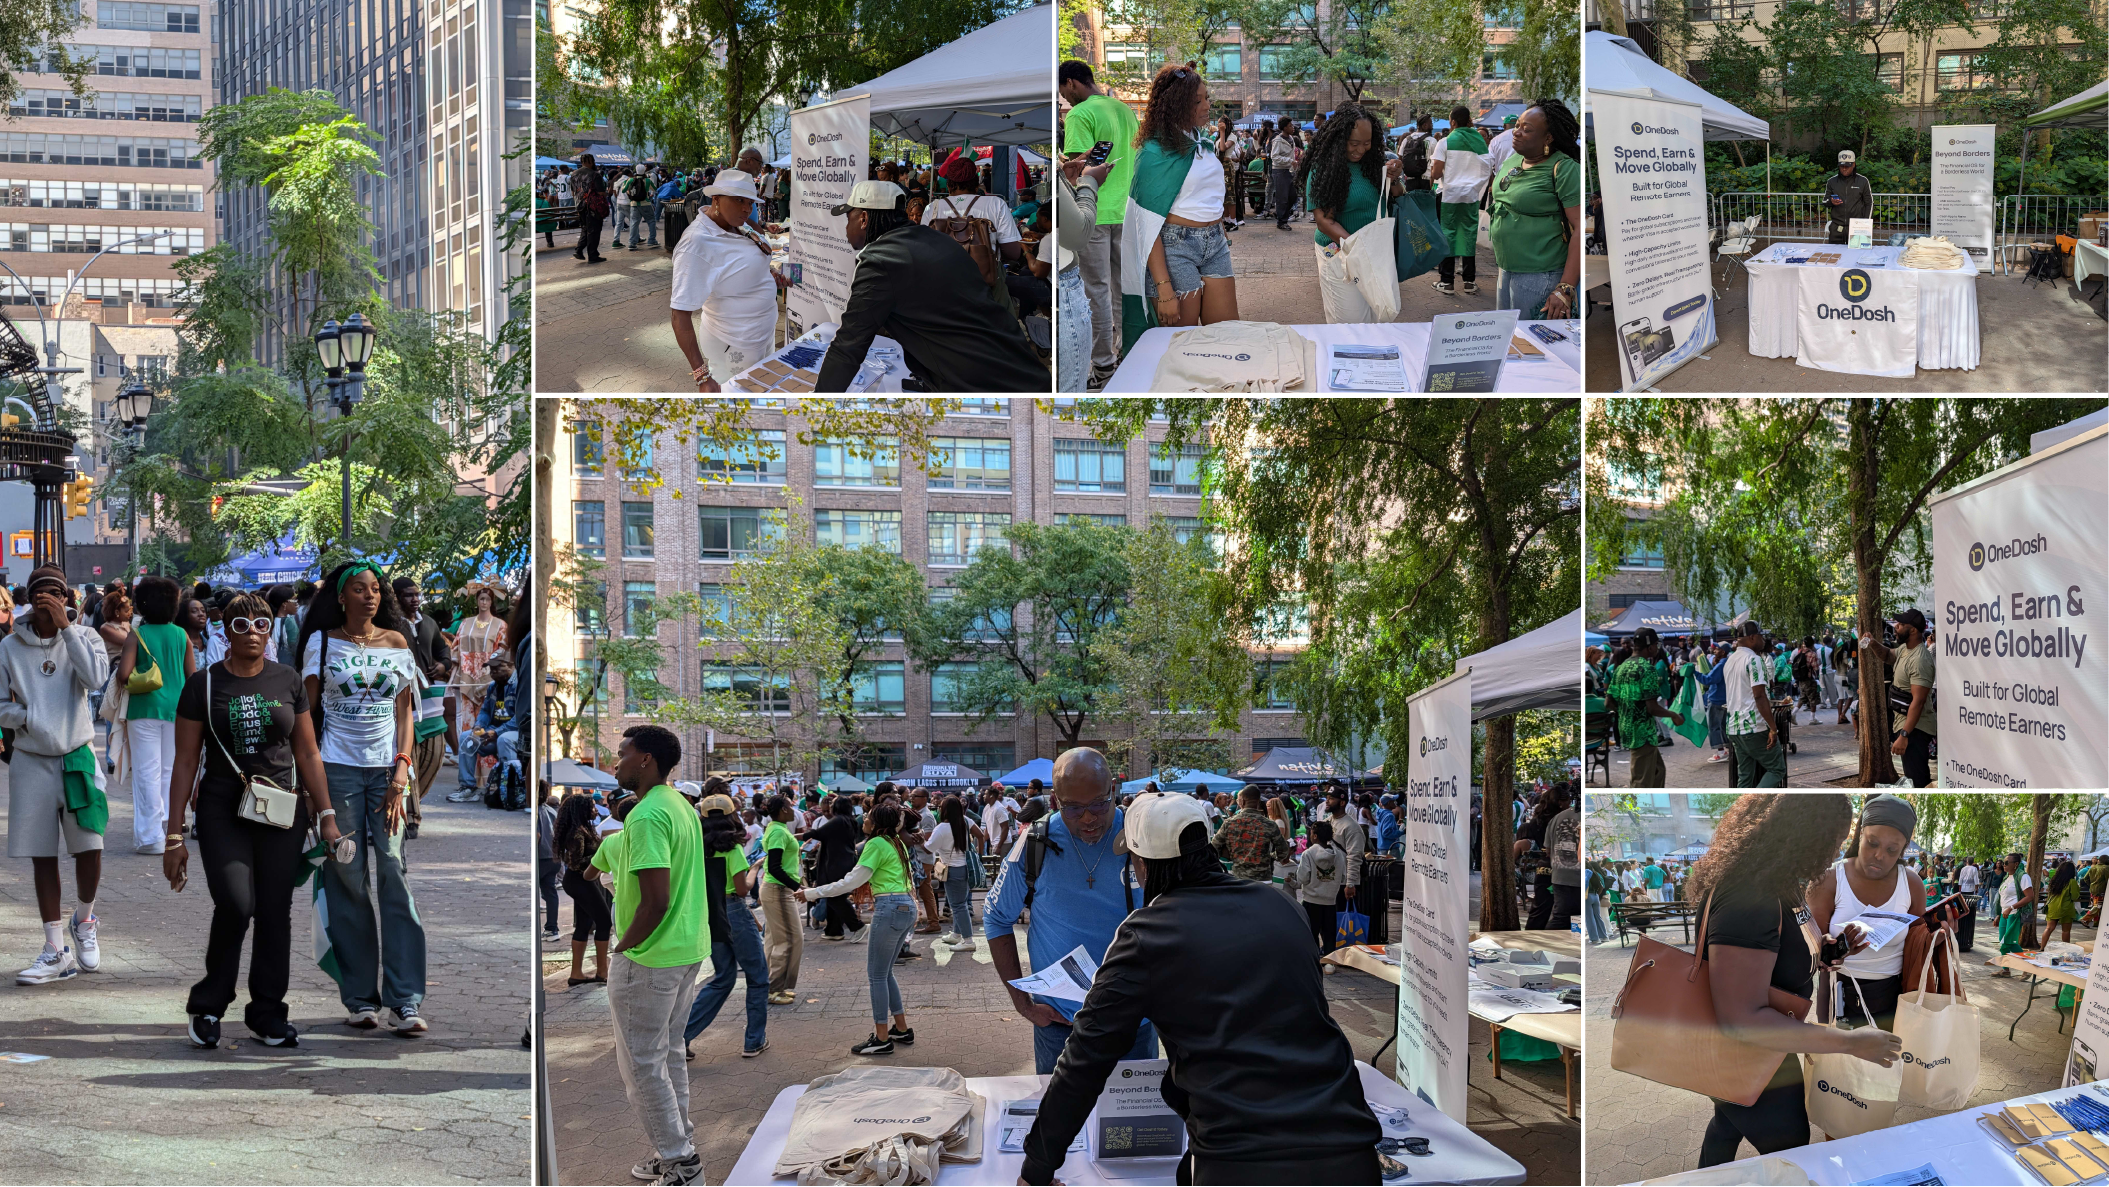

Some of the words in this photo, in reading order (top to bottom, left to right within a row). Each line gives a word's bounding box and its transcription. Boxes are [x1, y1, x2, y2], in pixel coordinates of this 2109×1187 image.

[816, 132, 842, 142] OneDosh
[1645, 126, 1679, 135] OneDosh
[1614, 146, 1659, 162] Spend,
[1662, 148, 1686, 158] Earn
[1689, 148, 1695, 158] &
[796, 156, 824, 170] Spend,
[826, 156, 846, 168] Earn
[849, 154, 856, 166] &
[1615, 162, 1650, 174] Move
[1652, 161, 1696, 174] Globally
[796, 170, 816, 182] Move
[818, 170, 856, 186] Globally
[1633, 182, 1651, 191] Built
[1664, 180, 1688, 189] Global
[801, 200, 821, 208] Remote
[1638, 215, 1661, 223] OneDosh
[1628, 243, 1667, 257] High-Capacity
[1625, 258, 1637, 266] High
[1626, 263, 1654, 275] conversions
[1632, 280, 1645, 289] Zero
[1817, 303, 1895, 322] OneDosh
[1442, 336, 1470, 345] Beyond
[1988, 533, 2047, 562] OneDosh
[258, 572, 276, 584] JERK
[1946, 595, 2005, 632] Spend,
[2011, 592, 2061, 620] Earn
[2067, 585, 2085, 616] &
[1641, 615, 1692, 627] native
[1946, 633, 1991, 658] Move
[1995, 627, 2087, 668] Globally
[1963, 680, 1990, 699] Built
[1993, 682, 2009, 701] for
[2012, 683, 2059, 707] Global
[332, 701, 362, 714] West
[1960, 706, 2006, 730] Remote
[2008, 713, 2066, 741] Earners
[1428, 735, 1448, 752] OneDosh
[1278, 762, 1334, 773] native
[1951, 760, 1965, 774] The
[1966, 764, 2002, 785] OneDosh
[2004, 774, 2026, 788] Card
[1410, 777, 1431, 802] Spend,
[1433, 776, 1450, 798] Earn
[1452, 775, 1457, 798] &
[1946, 776, 1956, 788] Pay
[1409, 803, 1426, 822] Move
[1427, 803, 1457, 834] Globally
[1413, 839, 1424, 854] Built
[1431, 842, 1447, 860] Global
[1411, 858, 1428, 877] Remote
[1429, 864, 1448, 885] Earners
[2093, 1002, 2106, 1013] Zero
[2085, 1018, 2101, 1031] human
[1916, 1056, 1950, 1069] OneDosh
[1831, 1086, 1868, 1110] OneDosh
